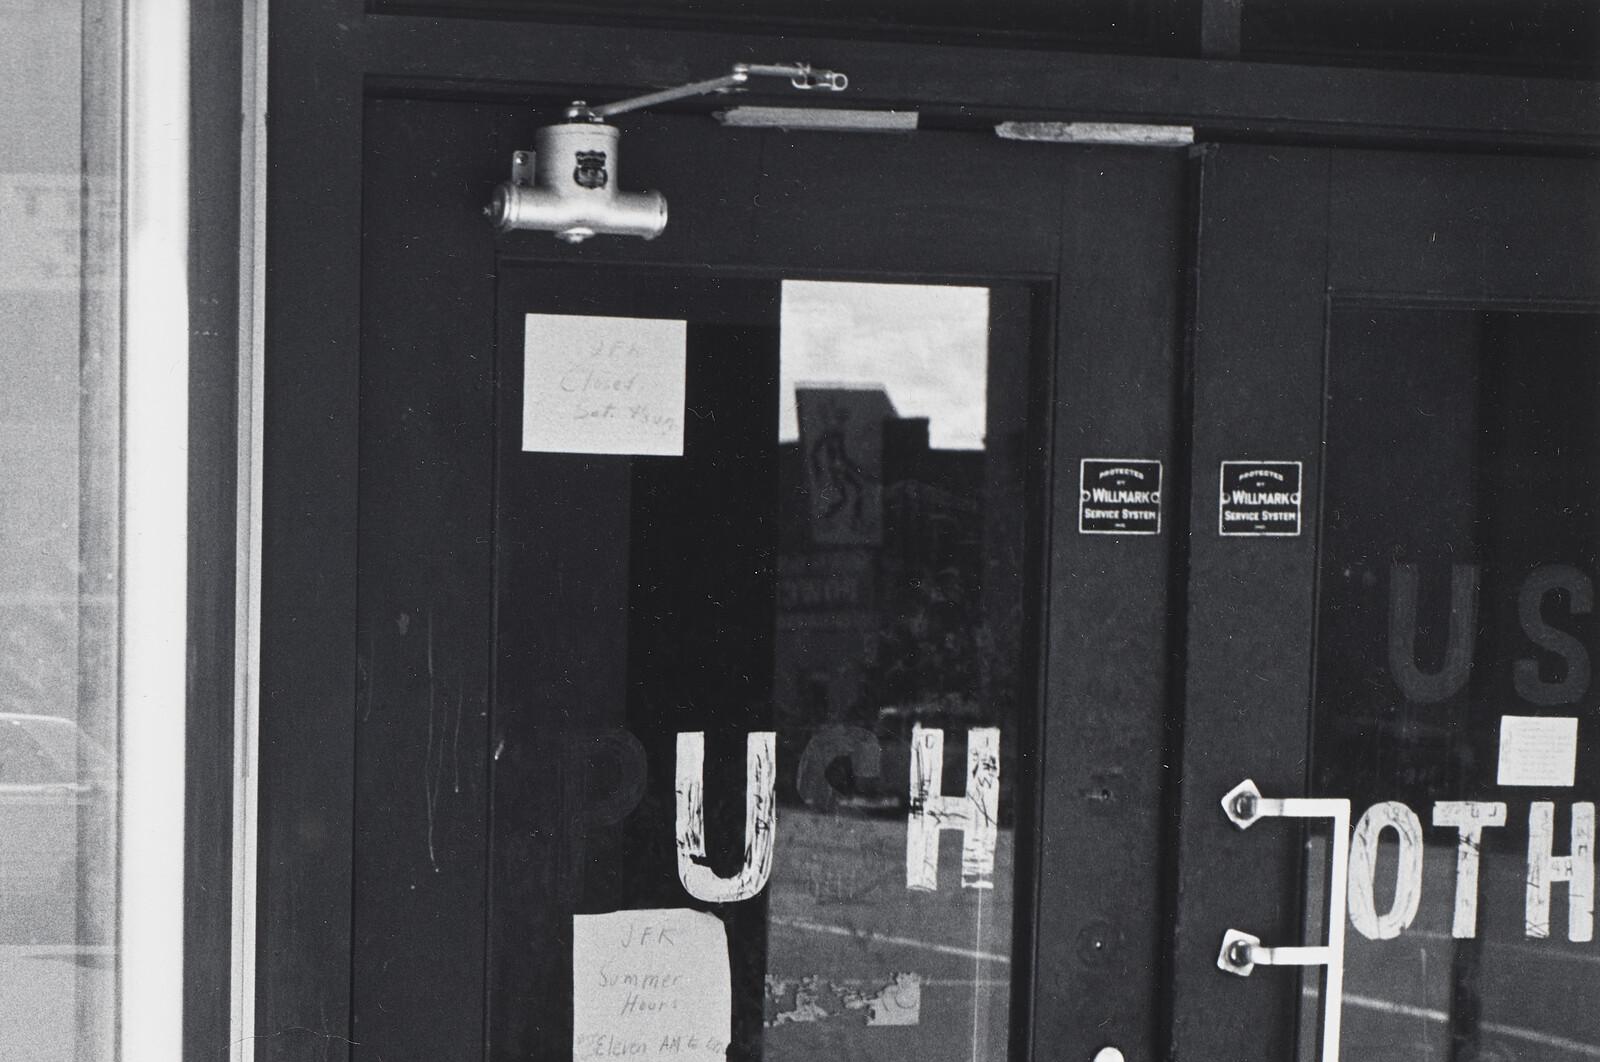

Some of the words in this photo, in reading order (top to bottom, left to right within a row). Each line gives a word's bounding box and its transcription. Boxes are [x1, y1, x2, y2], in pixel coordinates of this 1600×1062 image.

[1092, 487, 1150, 504] WILLMARK
[1232, 489, 1290, 506] WILLMARK
[1084, 508, 1120, 519] SERVICE
[1122, 508, 1156, 520] SYSTEM
[1224, 510, 1260, 521] SERVICE
[1262, 510, 1296, 522] SYSTEM
[621, 923, 677, 948] JFK
